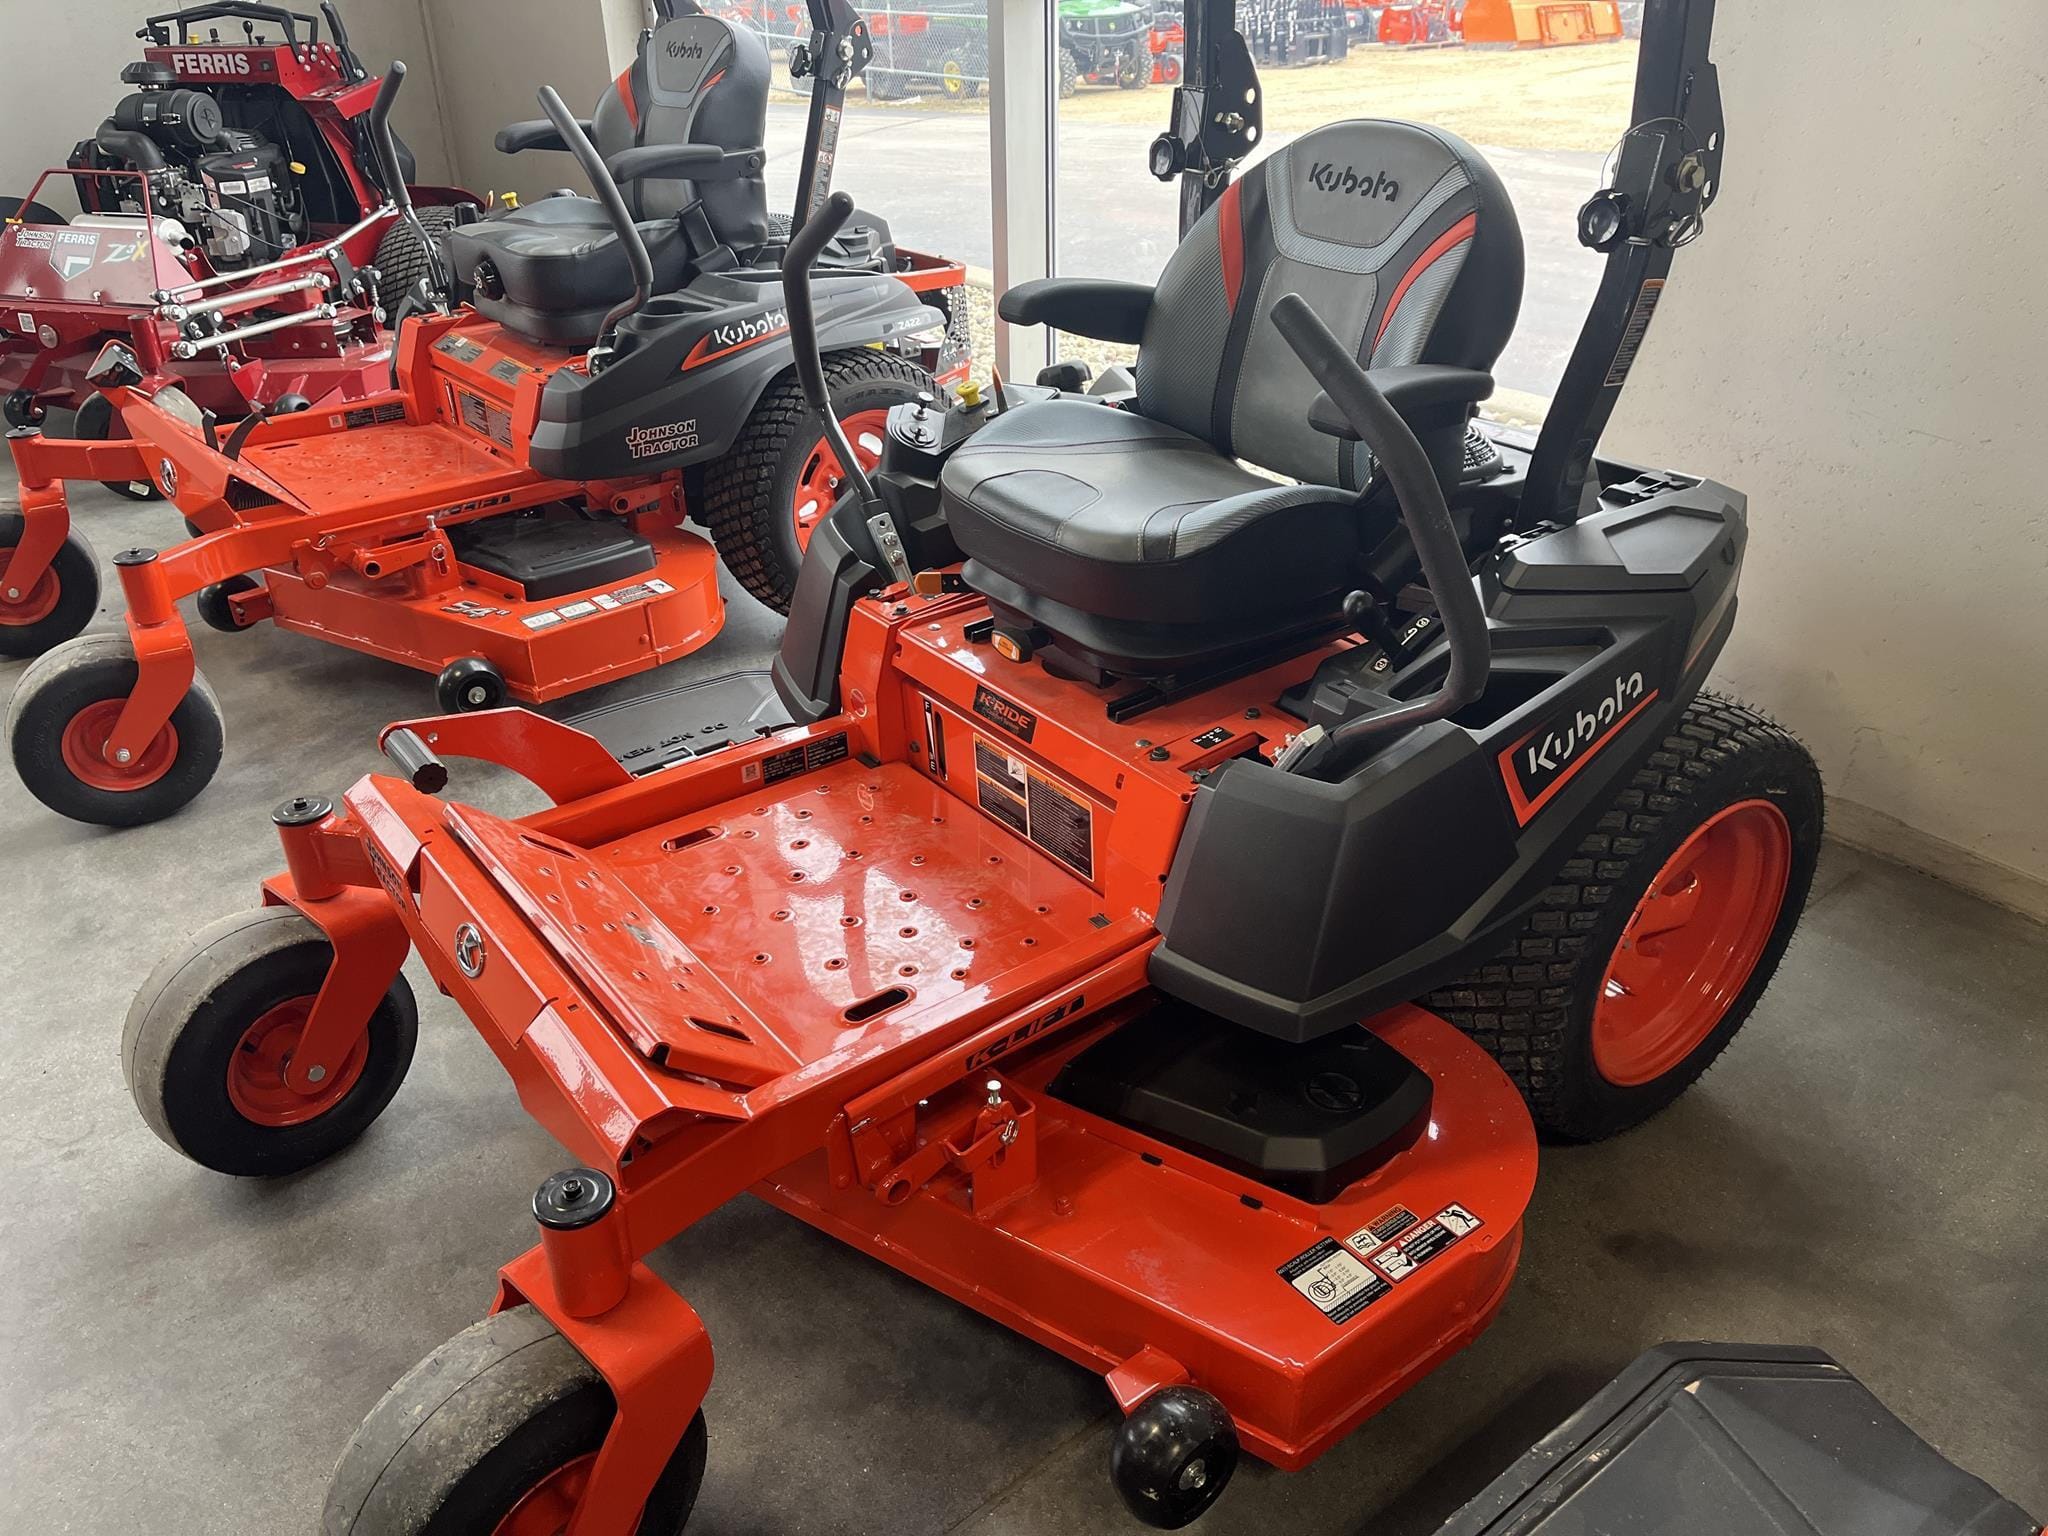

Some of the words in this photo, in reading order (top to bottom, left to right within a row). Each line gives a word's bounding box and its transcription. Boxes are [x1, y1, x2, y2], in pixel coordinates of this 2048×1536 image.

[666, 41, 702, 59] Kubota
[172, 53, 250, 75] FERRIS
[1309, 162, 1399, 202] Kubota
[15, 238, 51, 249] TRACTOR
[17, 228, 55, 240] JOHNSON
[58, 232, 96, 245] FERRIS
[713, 311, 786, 345] Kubota
[626, 419, 696, 444] JOHNSON
[630, 435, 698, 458] TRACTOR
[980, 692, 1031, 729] K-RIDE
[1528, 671, 1644, 775] Kubota
[969, 996, 1076, 1070] K-LIFT
[1403, 1219, 1437, 1242] DANGER
